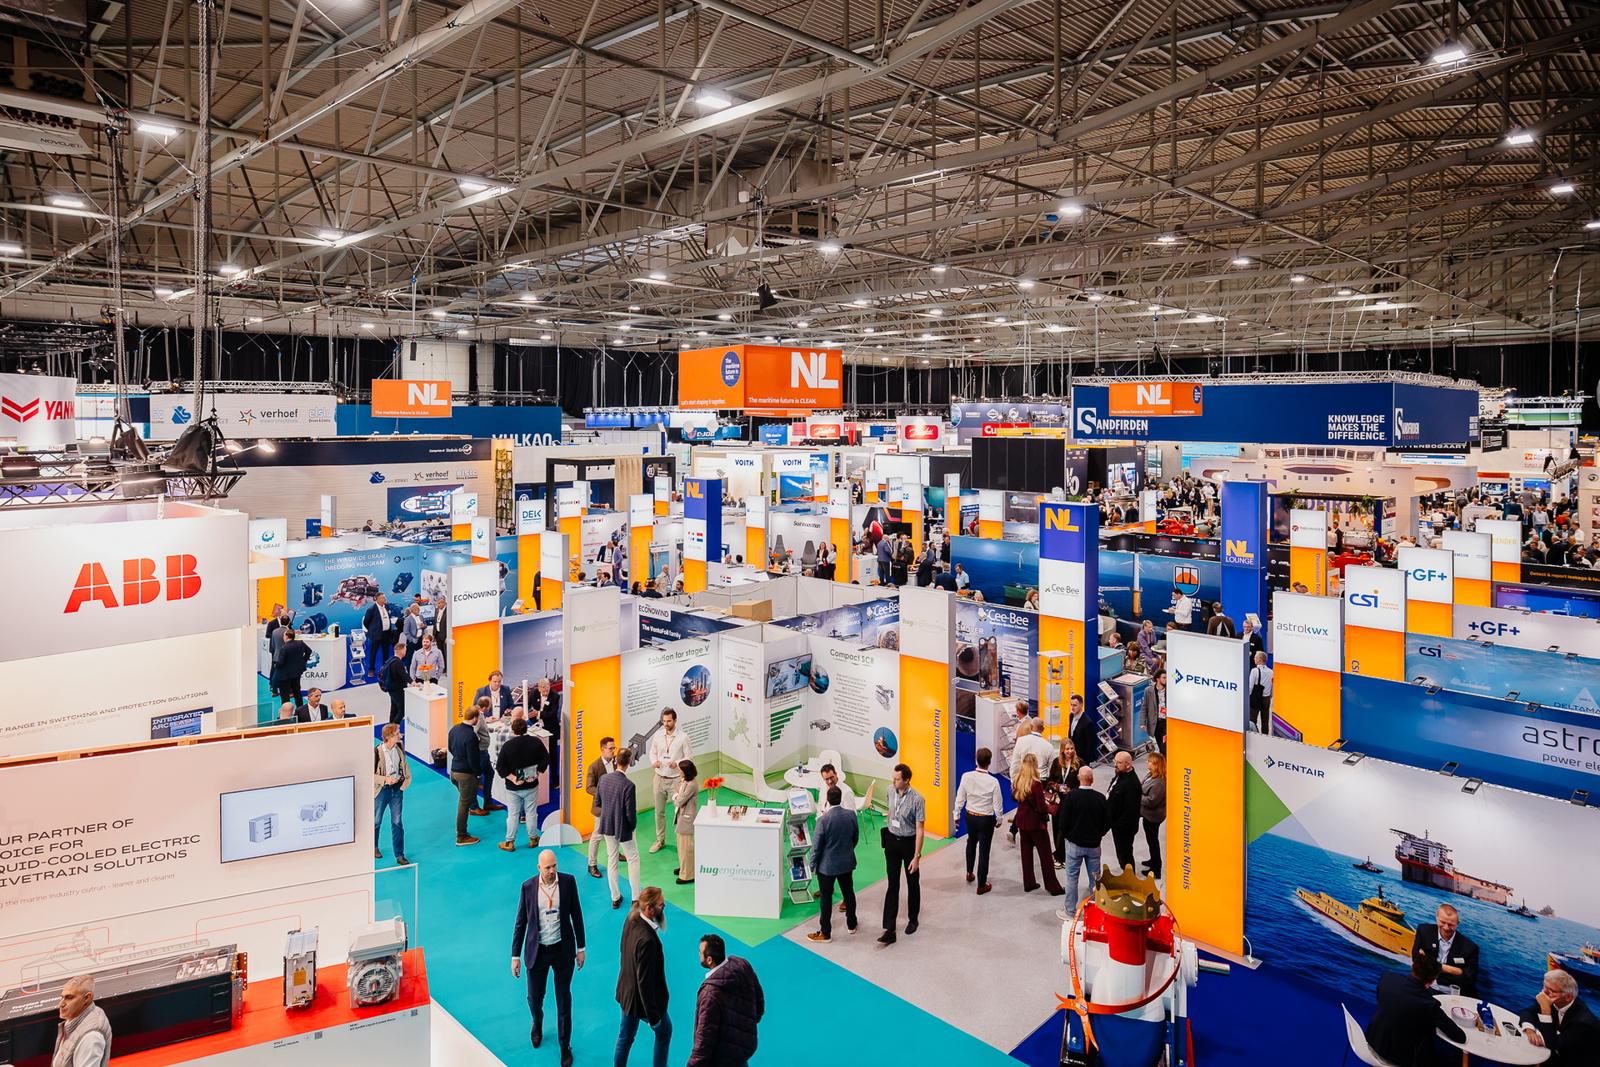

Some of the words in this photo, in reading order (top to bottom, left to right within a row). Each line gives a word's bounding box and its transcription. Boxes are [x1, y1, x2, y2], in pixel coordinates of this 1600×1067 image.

[791, 351, 839, 389] NL
[408, 383, 448, 405] NL
[1136, 384, 1170, 405] NL
[260, 409, 298, 418] verhoef
[1077, 408, 1149, 434] SANDFIRDEN
[1328, 415, 1385, 423] KNOWLEDGE
[1328, 423, 1359, 431] MAKES
[1361, 423, 1379, 431] THE
[686, 482, 704, 498] NL
[1045, 508, 1079, 532] NL
[1226, 540, 1254, 558] NL
[1225, 557, 1254, 565] LOUNGE
[63, 554, 202, 613] ABB
[453, 590, 498, 602] ECONOWIND
[638, 604, 669, 617] ECONOWIND
[988, 609, 1029, 626] Cee-Bee
[1468, 620, 1521, 636] +GF+
[648, 652, 674, 663] Solution
[675, 651, 685, 659] for
[686, 648, 703, 658] stage
[829, 648, 861, 664] Compact
[1186, 674, 1238, 692] PENTAIR
[5, 723, 35, 733] RANGE
[49, 712, 98, 724] SWITCHING
[99, 708, 117, 716] AND
[118, 698, 167, 711] PROTECTION
[168, 691, 209, 702] SOLUTIONS
[152, 711, 204, 725] INTEGRATED
[575, 710, 584, 730] hug
[933, 709, 941, 728] hug
[151, 723, 169, 731] ARC
[575, 731, 583, 790] engineering
[933, 729, 941, 788] engineering
[1543, 753, 1581, 767] power
[1278, 760, 1325, 778] PENTAIR
[1183, 768, 1192, 807] Pentair
[28, 822, 108, 842] PARTNER
[112, 818, 134, 829] OF
[1183, 808, 1191, 853] Fairbanks
[0, 845, 44, 860] OICE
[49, 839, 84, 854] FOR
[121, 835, 200, 854] ELECTRIC
[93, 850, 187, 872] SOLUTIONS
[1181, 855, 1191, 890] Nijhuis
[49, 888, 81, 901] industry
